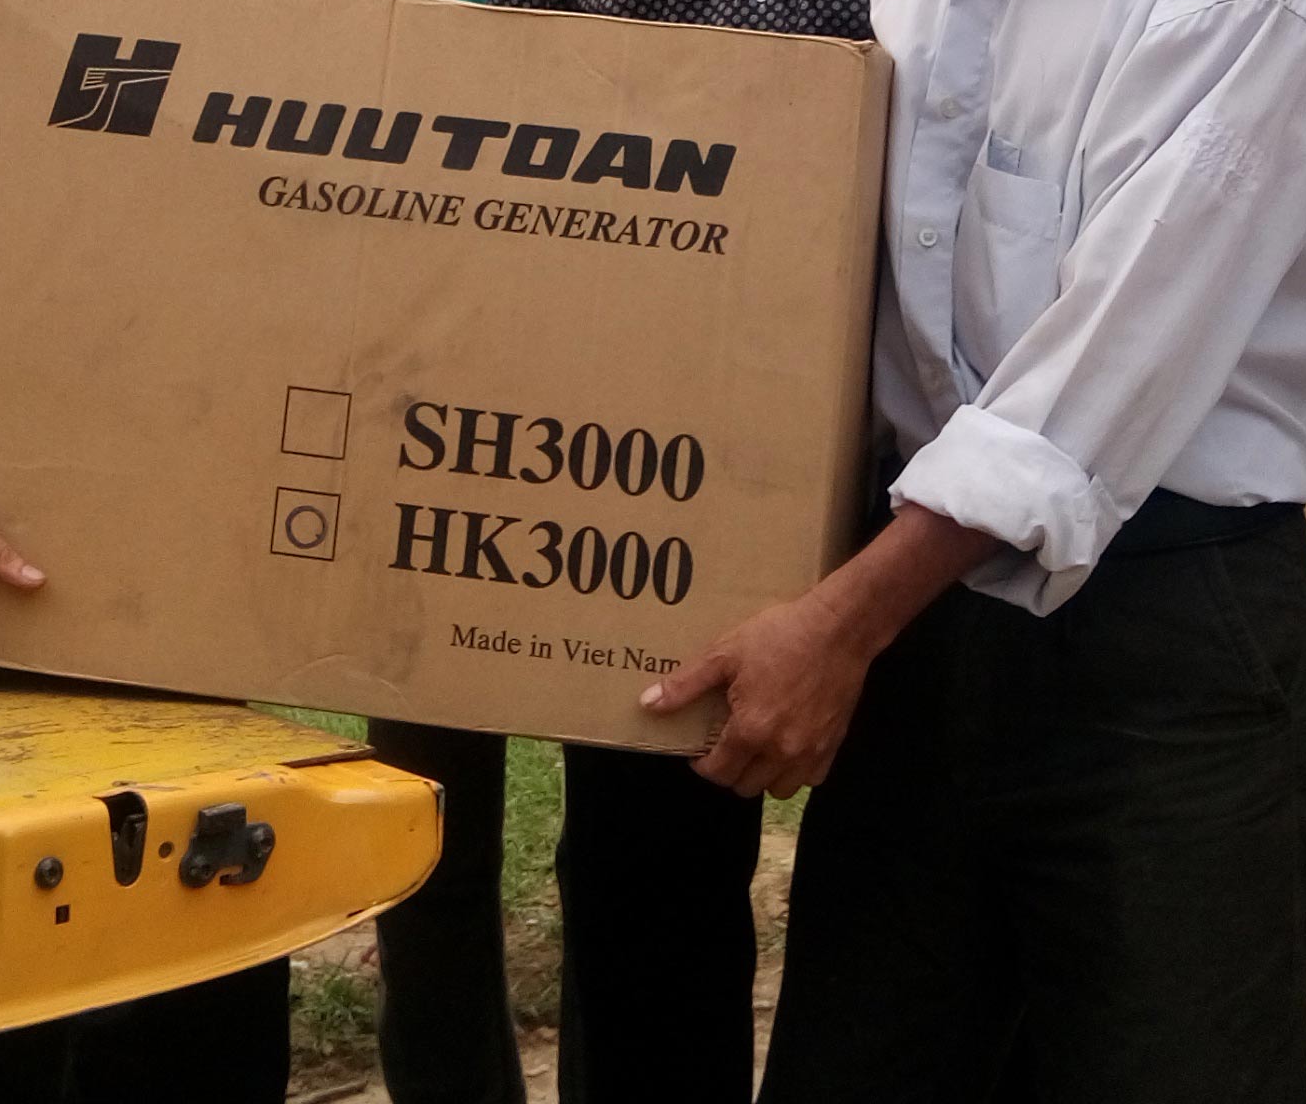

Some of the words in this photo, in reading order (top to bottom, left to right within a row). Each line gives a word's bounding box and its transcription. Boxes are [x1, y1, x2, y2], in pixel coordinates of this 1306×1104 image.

[258, 175, 465, 227] GASOLINE
[473, 198, 729, 255] GENERATOR
[398, 400, 704, 502] SH3000
[388, 502, 693, 606] HK3000
[450, 624, 521, 654] Made
[529, 634, 552, 659] in
[562, 638, 615, 667] Viet
